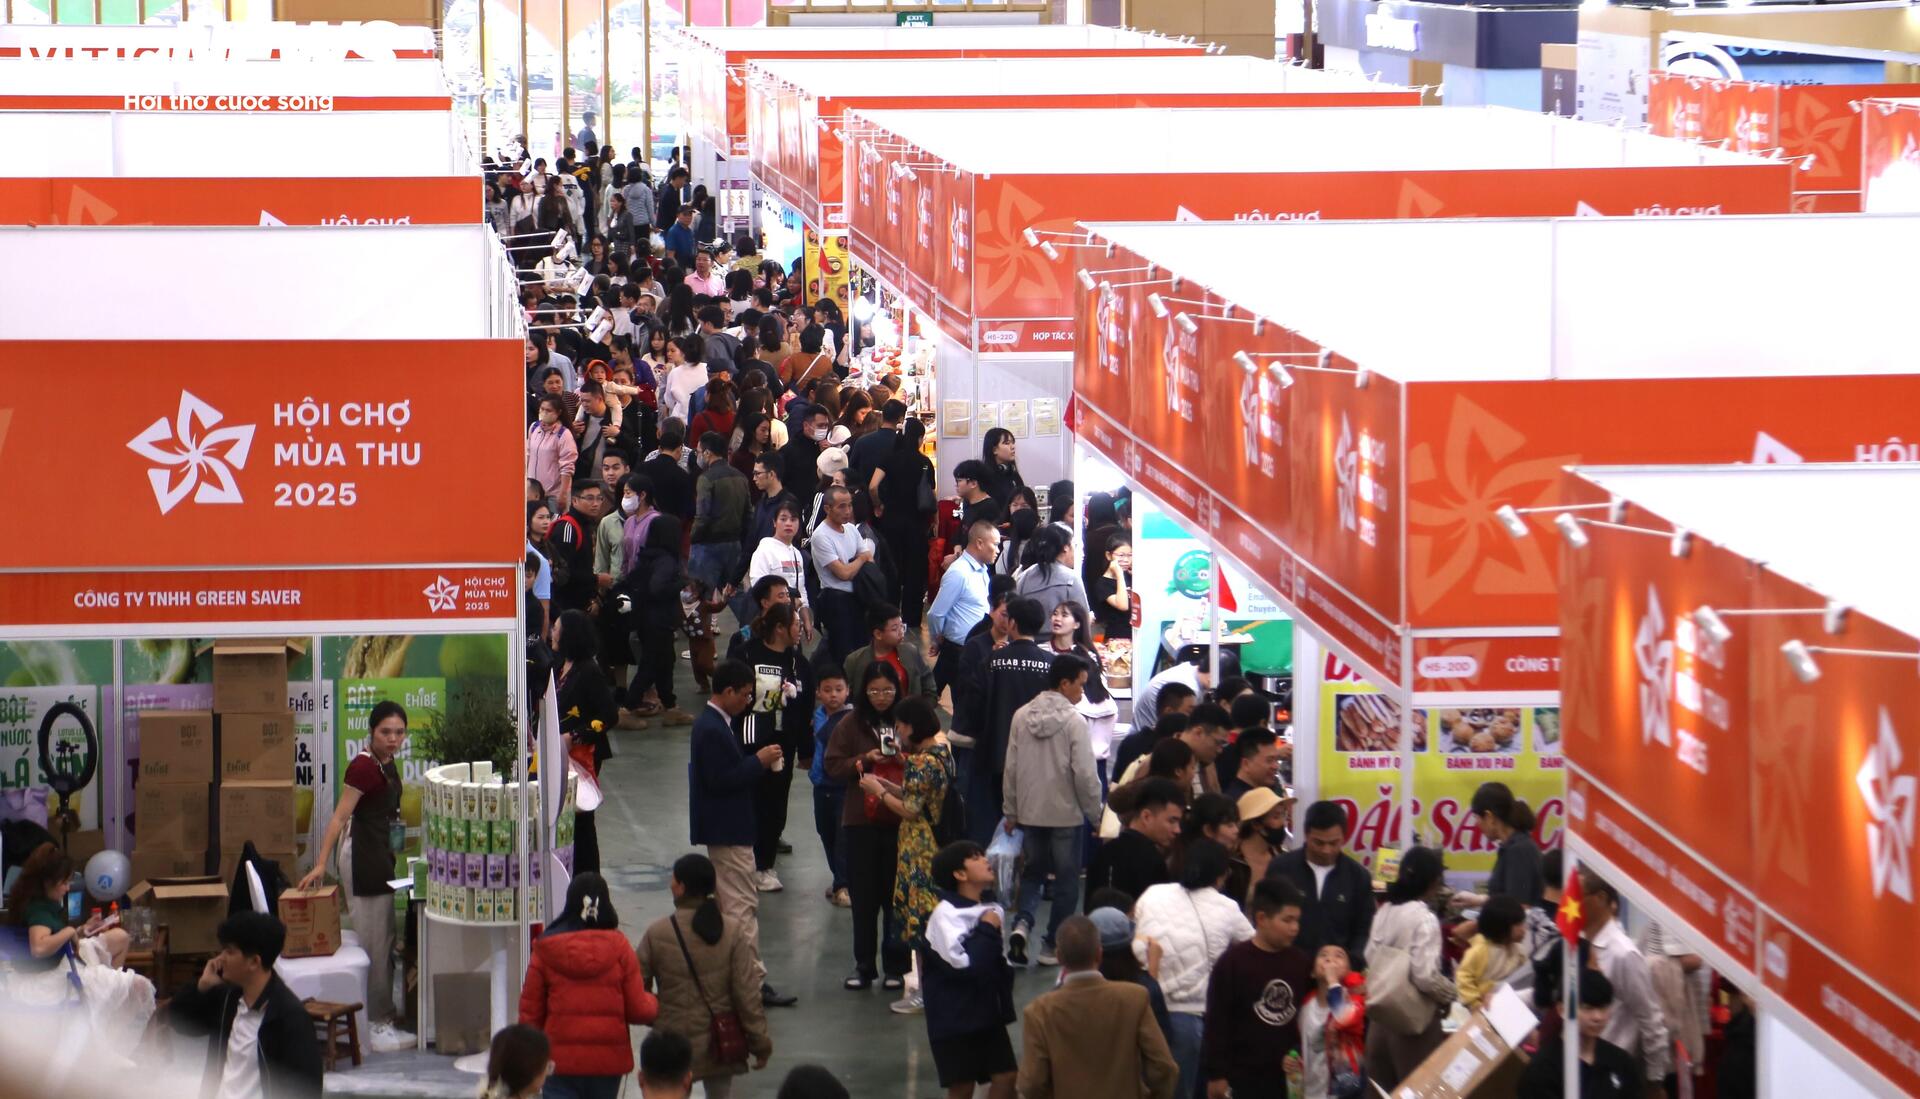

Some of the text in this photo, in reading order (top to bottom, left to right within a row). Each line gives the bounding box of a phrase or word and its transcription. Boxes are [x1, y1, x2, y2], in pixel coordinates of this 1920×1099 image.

[273, 396, 411, 434] HỘI CHỢ
[274, 435, 421, 467] MÙA THU
[273, 482, 358, 507] 2025
[464, 575, 505, 589] HỘI CHỢ
[73, 589, 301, 608] CÔNG TY TNHH GREEN SAVER
[464, 587, 509, 599] MÙA THU
[464, 601, 490, 611] 2025
[1505, 655, 1549, 673] CÔNG
